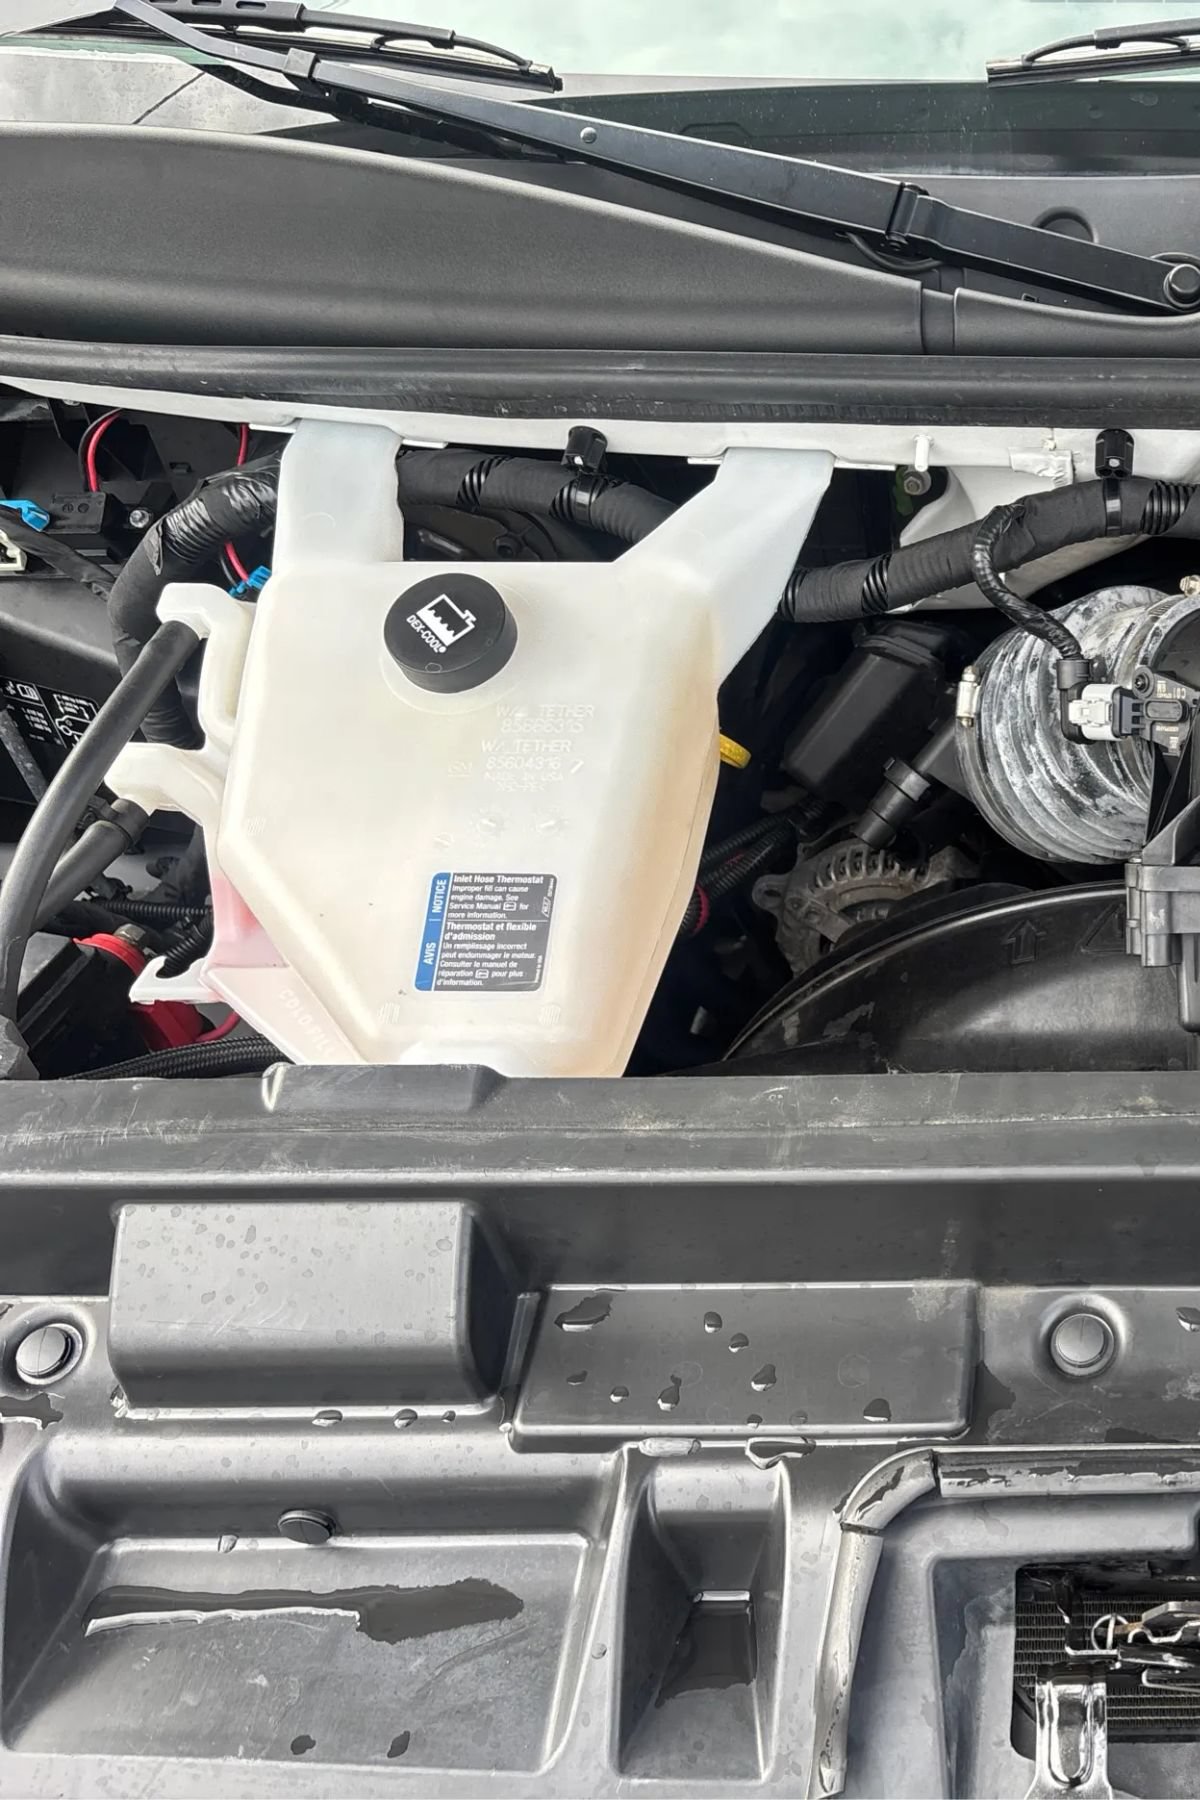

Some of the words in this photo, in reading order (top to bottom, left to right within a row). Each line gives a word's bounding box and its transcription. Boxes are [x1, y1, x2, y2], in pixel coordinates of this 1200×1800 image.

[514, 739, 572, 753] TETHER
[453, 875, 473, 883] Inlet
[474, 875, 495, 883] Hose
[497, 876, 544, 884] Thermostat
[452, 884, 483, 893] Improper
[431, 879, 447, 913] NOTICE
[450, 894, 474, 902] engine
[475, 894, 504, 902] damage.
[449, 902, 475, 910] Service
[476, 902, 501, 910] Manual
[467, 911, 508, 919] information.
[446, 922, 494, 930] Thermostat
[506, 923, 537, 931] flexible
[444, 932, 496, 940] d'admission
[453, 943, 495, 951] remplissage
[422, 942, 437, 965] AVIS
[441, 952, 456, 960] peut
[458, 952, 502, 960] endommager
[438, 969, 474, 978] réparation
[491, 970, 507, 978] pour
[508, 970, 524, 978] plus
[436, 978, 484, 986] d'information.
